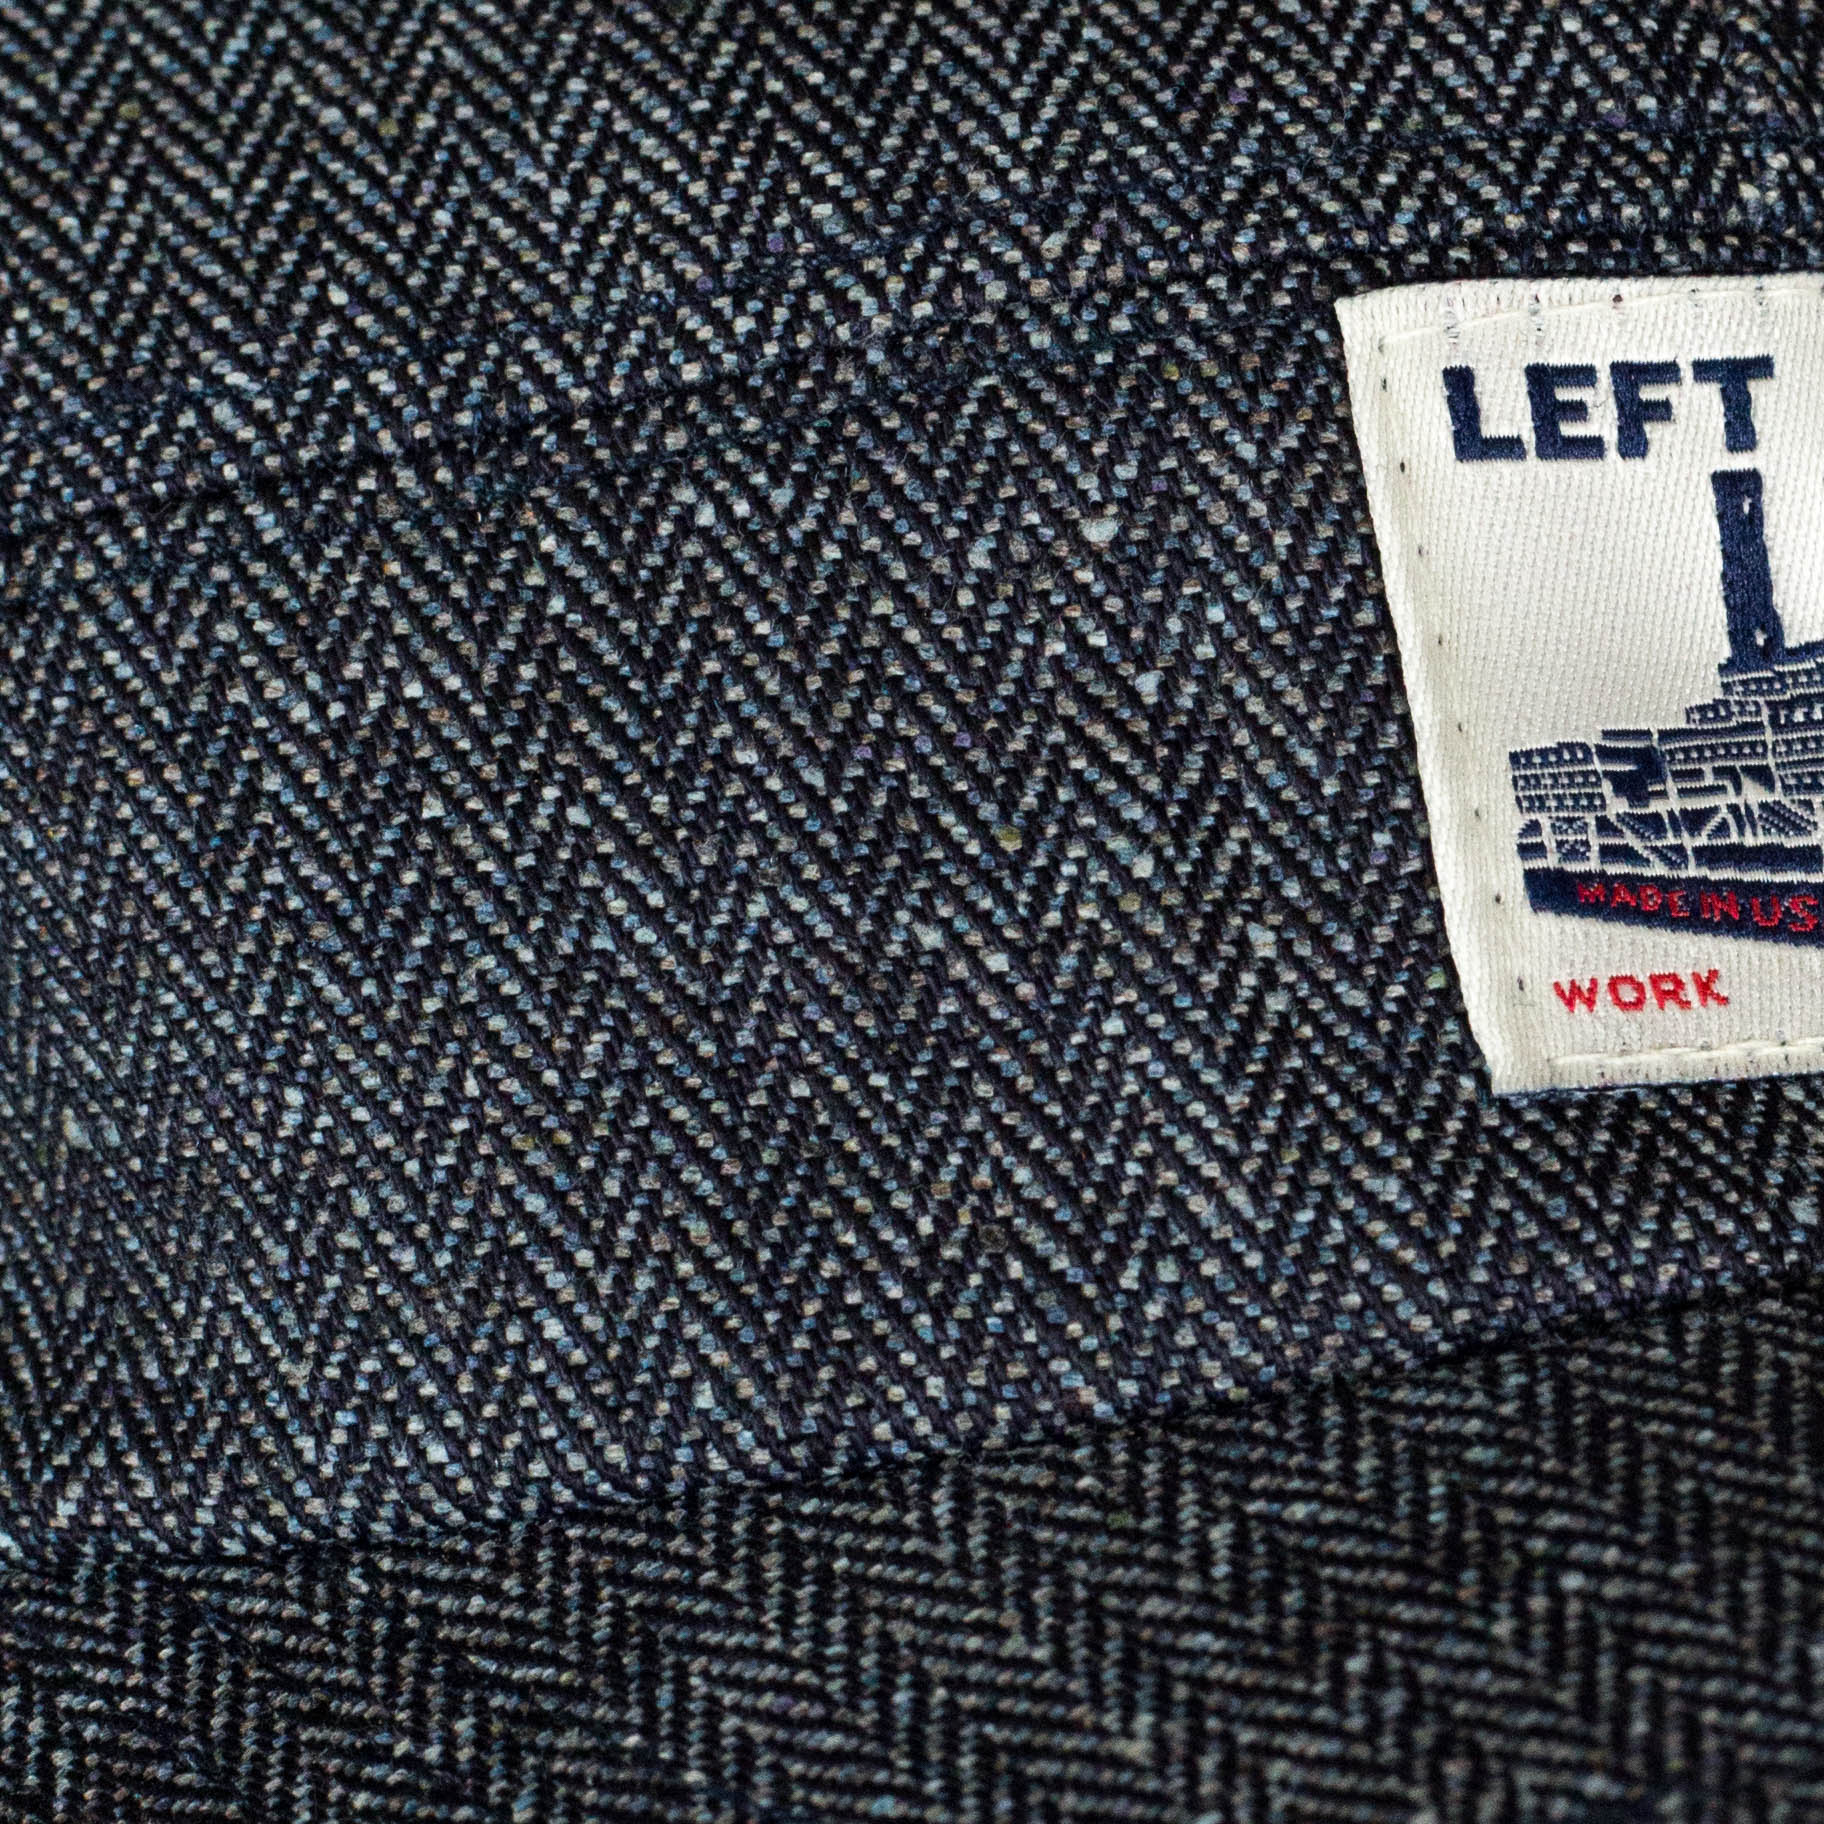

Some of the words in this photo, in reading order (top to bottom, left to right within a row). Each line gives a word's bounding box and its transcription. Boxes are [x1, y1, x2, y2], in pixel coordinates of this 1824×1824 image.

[1442, 354, 1775, 463] LEFT
[1576, 880, 1690, 918] MADE
[1699, 889, 1741, 922] IN
[1552, 968, 1730, 1014] WORK
